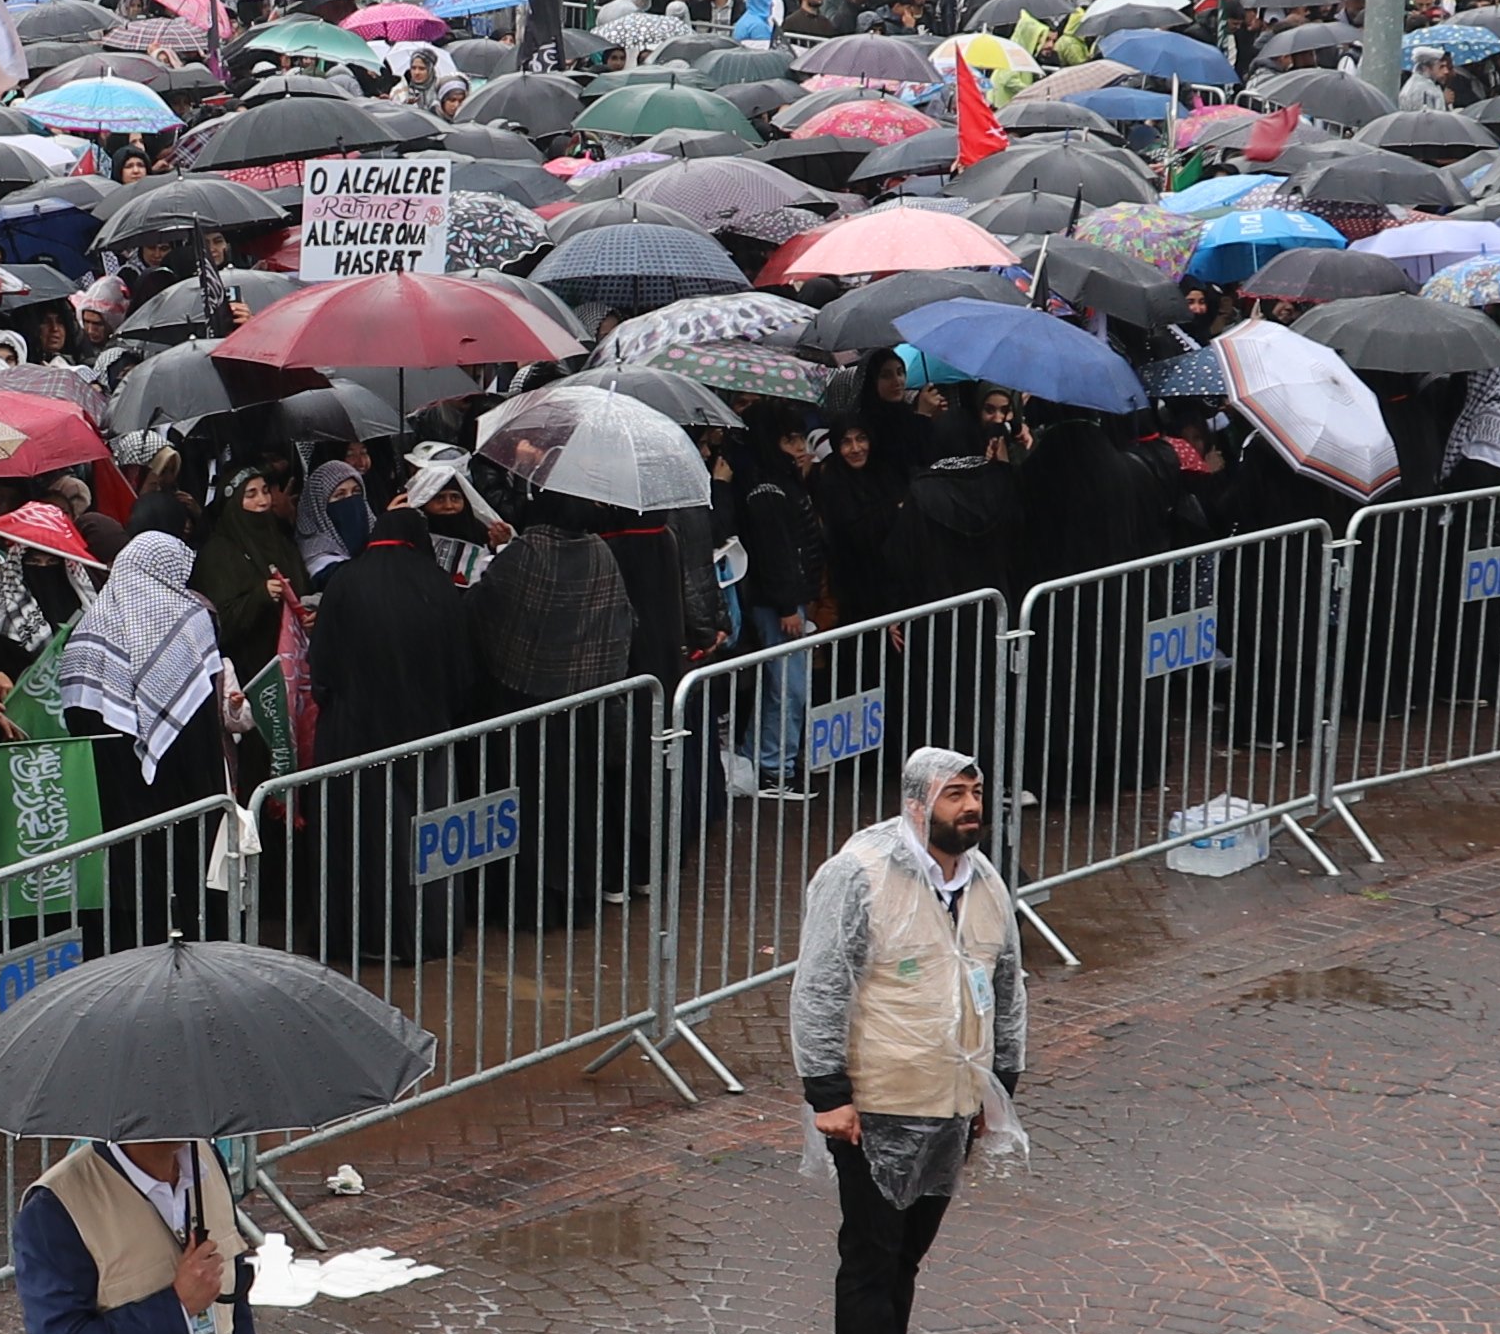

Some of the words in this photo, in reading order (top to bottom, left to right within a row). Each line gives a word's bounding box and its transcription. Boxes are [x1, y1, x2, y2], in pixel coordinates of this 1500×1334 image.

[310, 166, 328, 195] O
[336, 166, 446, 195] ALEMLERE
[313, 195, 422, 222] Rahmet
[1150, 614, 1215, 674] POLİS
[812, 696, 883, 766] POLİS
[418, 798, 519, 875] POLİS
